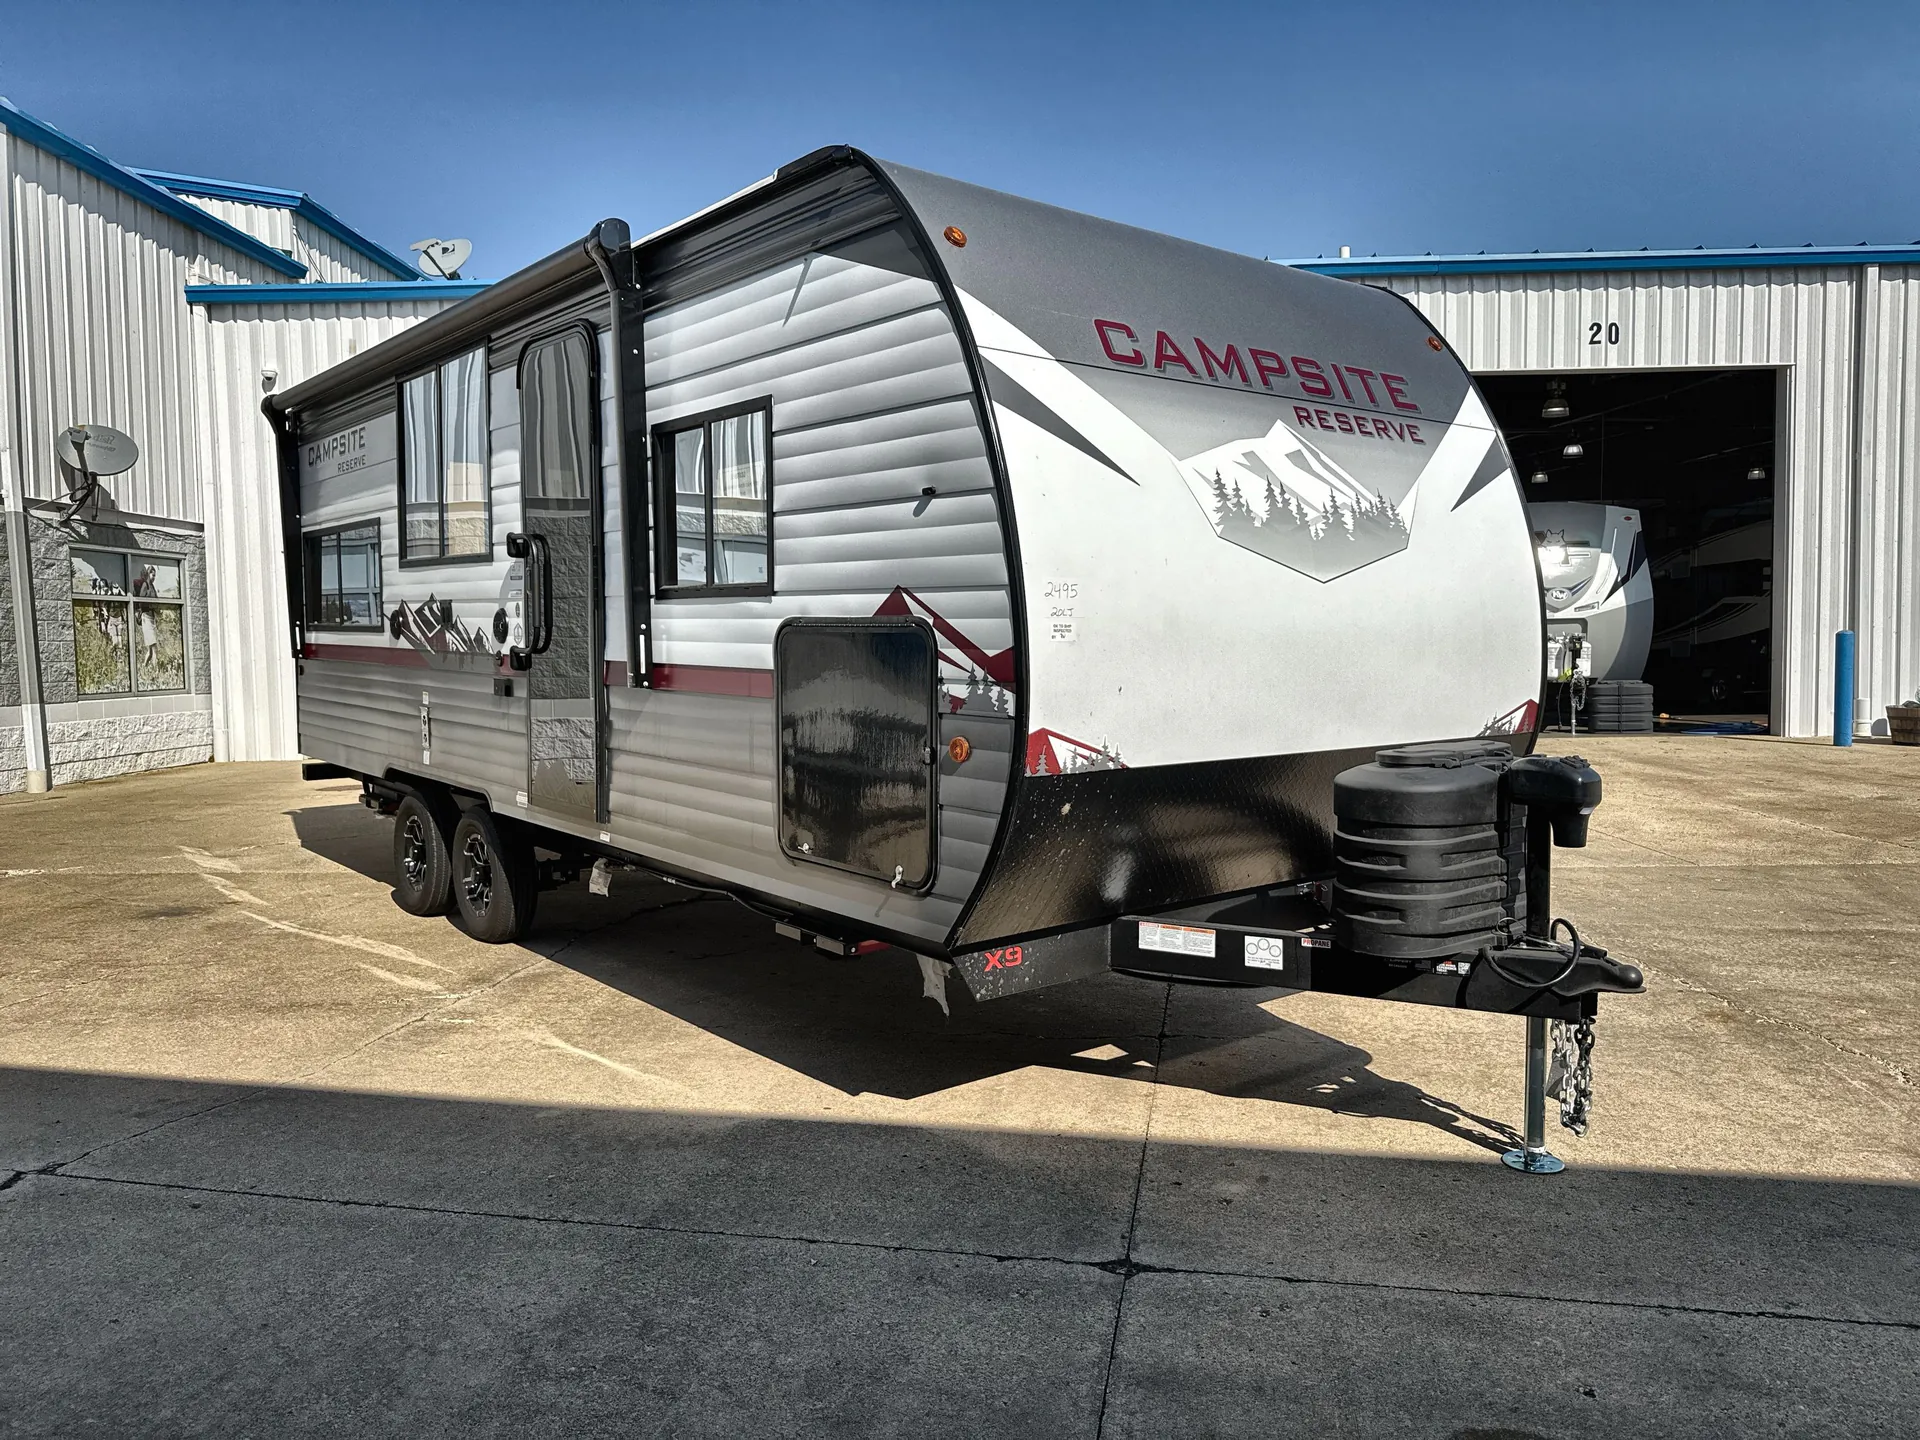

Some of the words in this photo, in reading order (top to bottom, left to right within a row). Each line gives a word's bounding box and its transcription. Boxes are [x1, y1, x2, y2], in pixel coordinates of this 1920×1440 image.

[1588, 322, 1620, 345] 20
[1094, 318, 1420, 413] CAMPSITE
[1292, 404, 1425, 444] RESERVE
[308, 426, 366, 467] CAMPSITE
[337, 454, 367, 474] RESERVE
[1044, 581, 1079, 599] 2495
[1303, 939, 1330, 947] PROPANE
